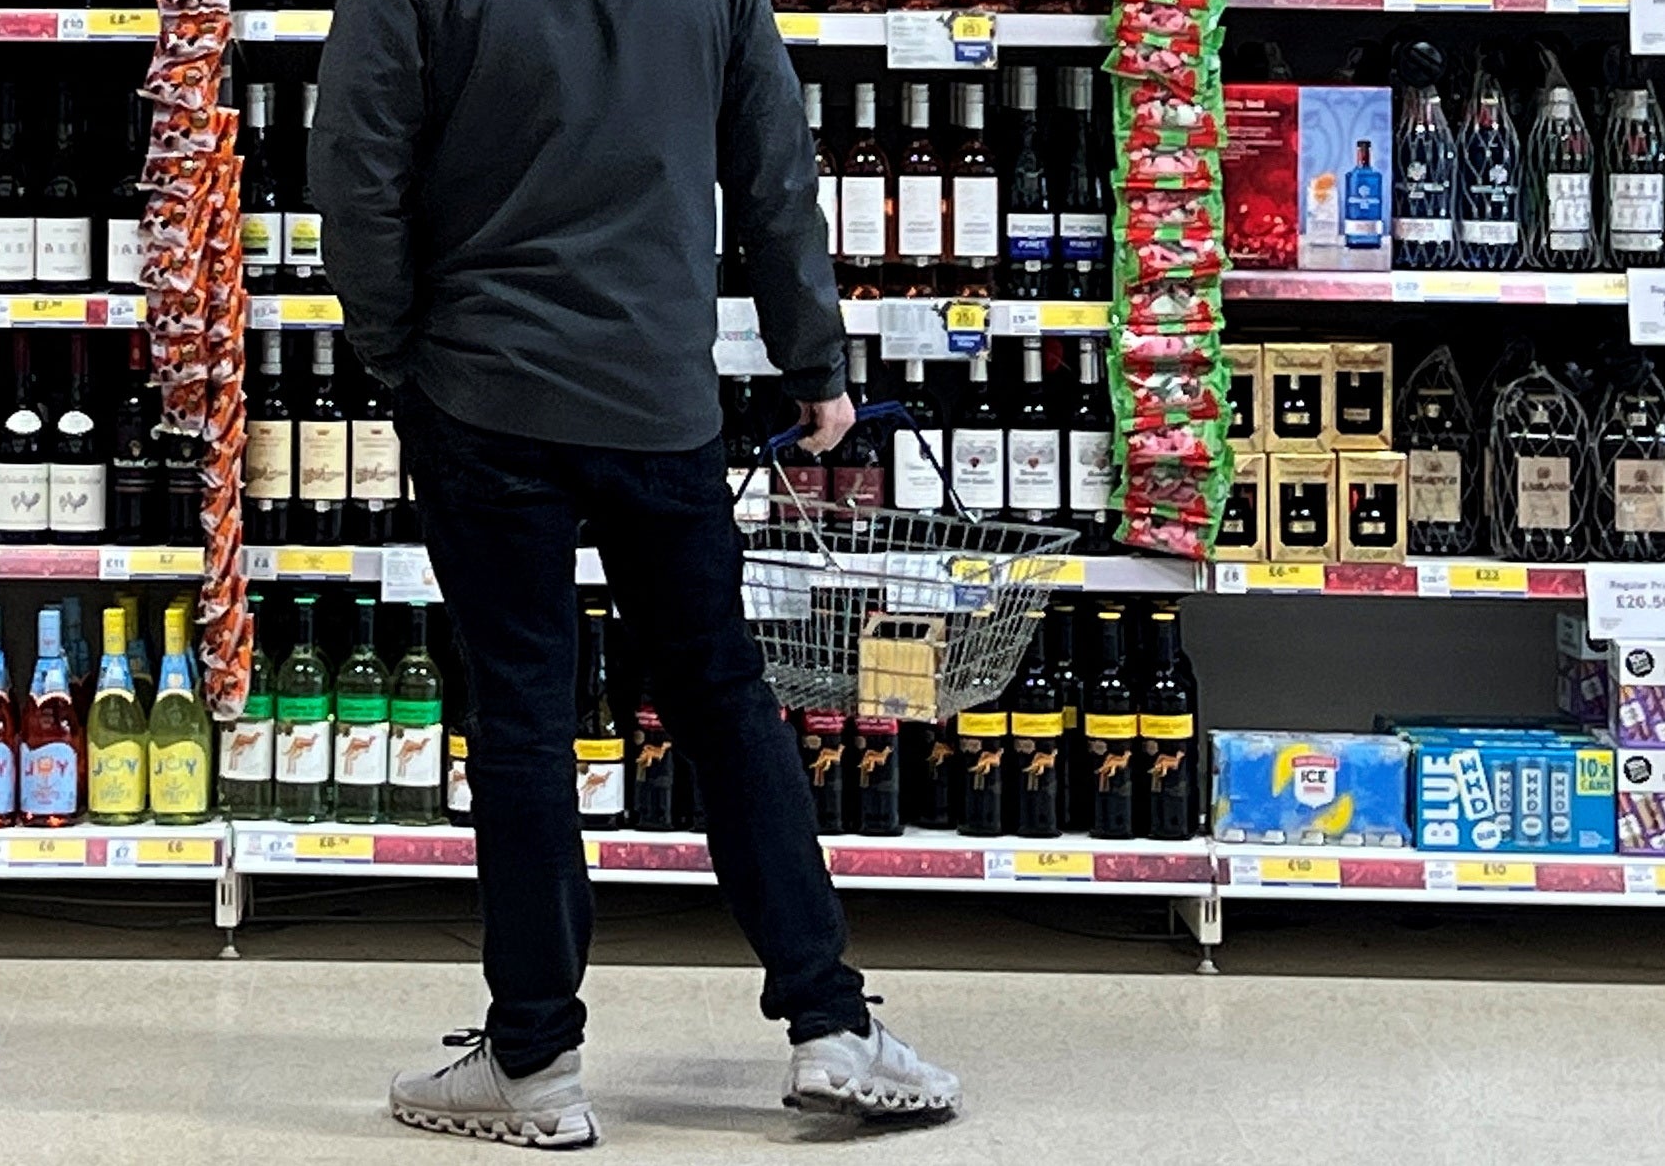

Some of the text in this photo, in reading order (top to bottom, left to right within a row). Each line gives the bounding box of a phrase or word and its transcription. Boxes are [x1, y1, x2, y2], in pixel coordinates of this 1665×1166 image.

[25, 755, 69, 777] JOY
[92, 754, 139, 776] JOY
[154, 754, 197, 776] JOY
[1300, 770, 1328, 783] ICE
[1459, 757, 1489, 815] WKD
[1422, 754, 1459, 847] BLUE
[1525, 772, 1539, 812] WKD
